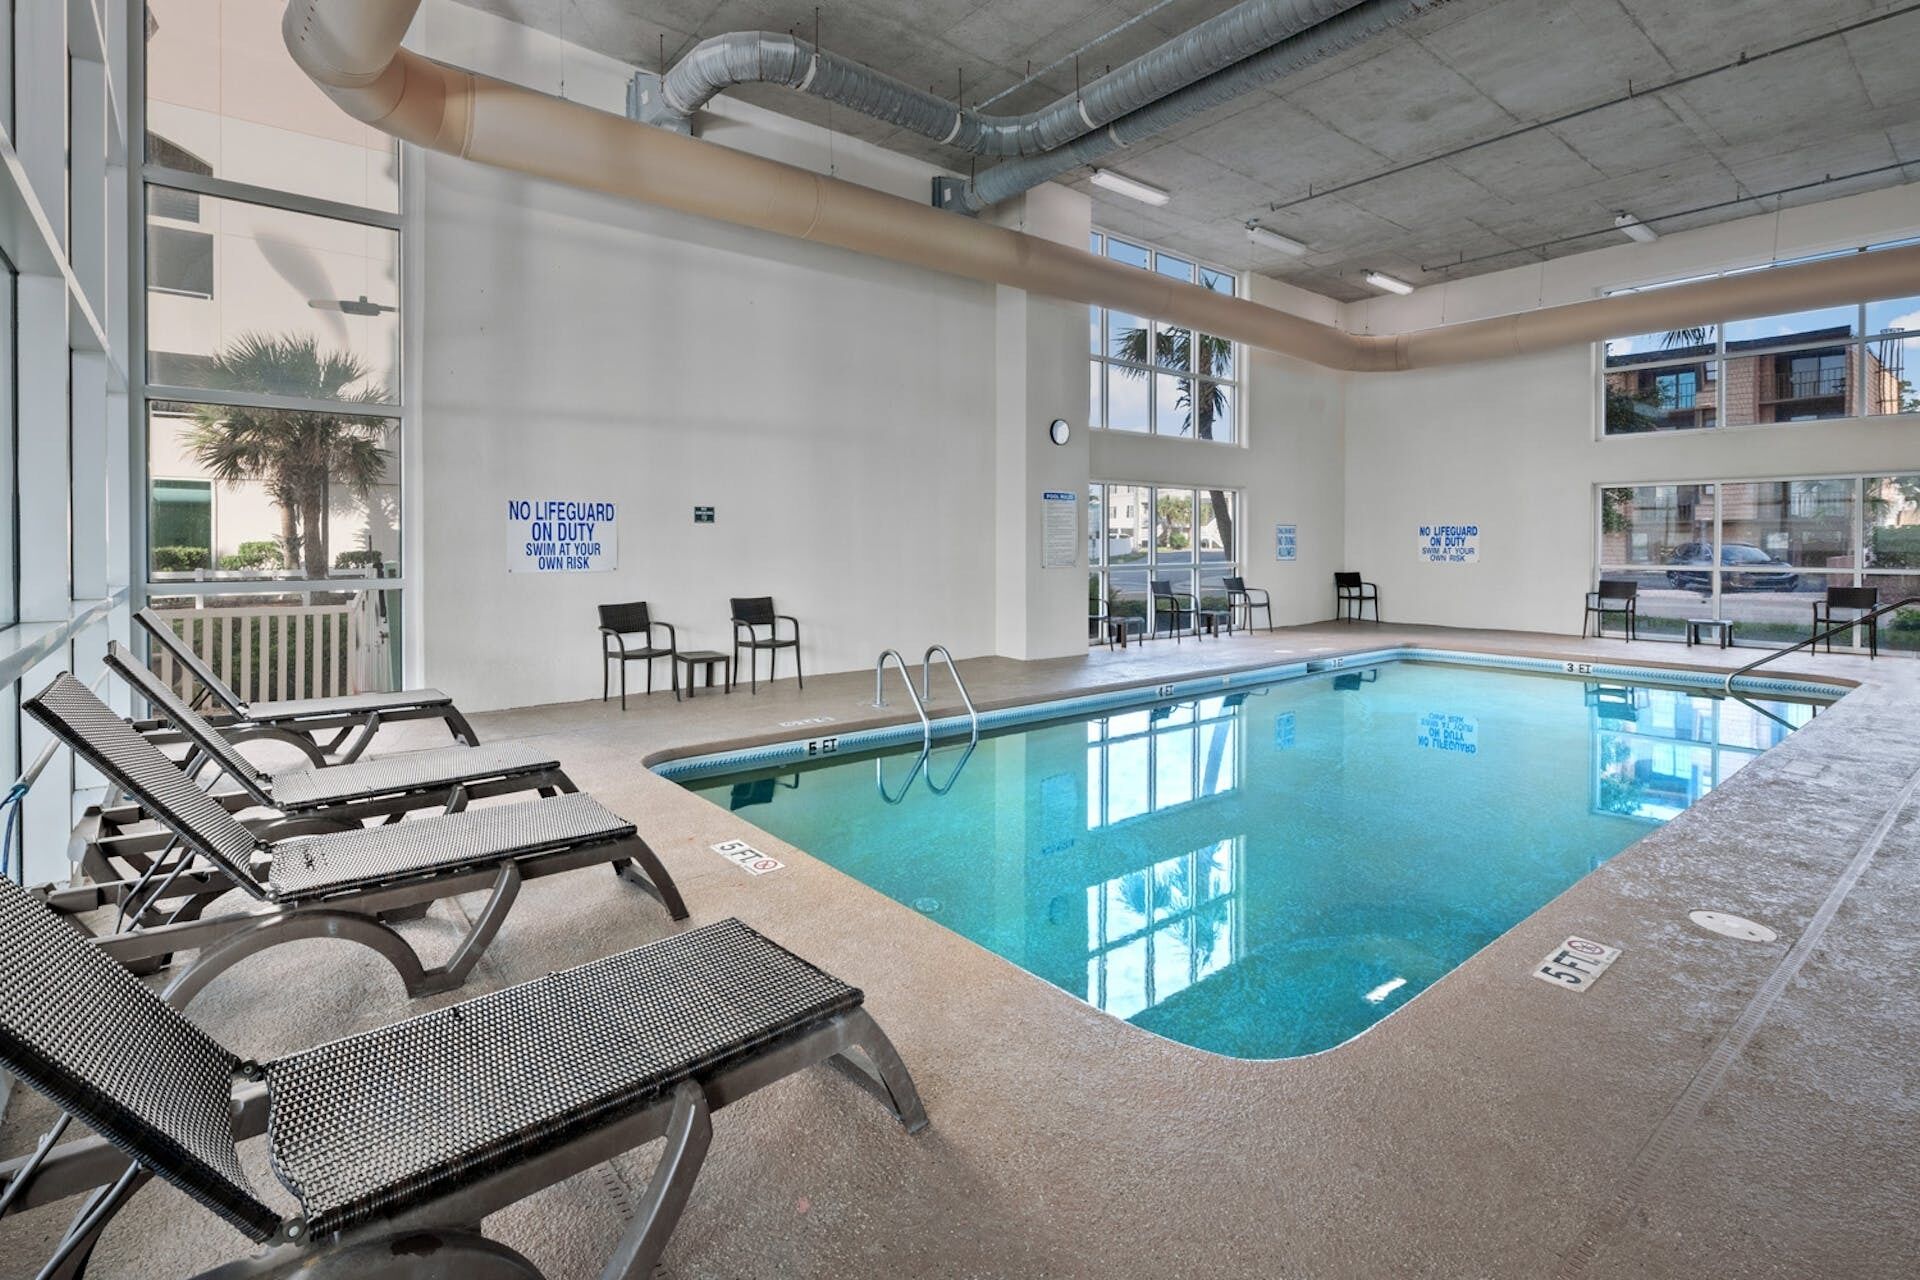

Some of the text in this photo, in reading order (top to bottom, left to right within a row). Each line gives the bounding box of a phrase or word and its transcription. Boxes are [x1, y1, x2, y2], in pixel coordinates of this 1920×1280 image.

[509, 500, 615, 521] NO LIFEGUARD
[532, 522, 594, 541] ON DUTY
[1419, 526, 1478, 536] NO LIFEGUARD
[1430, 537, 1466, 546] ON DUTY
[526, 542, 601, 556] SWIM AT YOUR
[1422, 547, 1440, 555] SWIM
[1455, 547, 1474, 555] YOUR
[538, 556, 590, 570] OWN RISK
[1567, 662, 1574, 673] 3
[809, 741, 817, 756] 5
[720, 842, 744, 850] 5
[1541, 966, 1581, 984] 5
